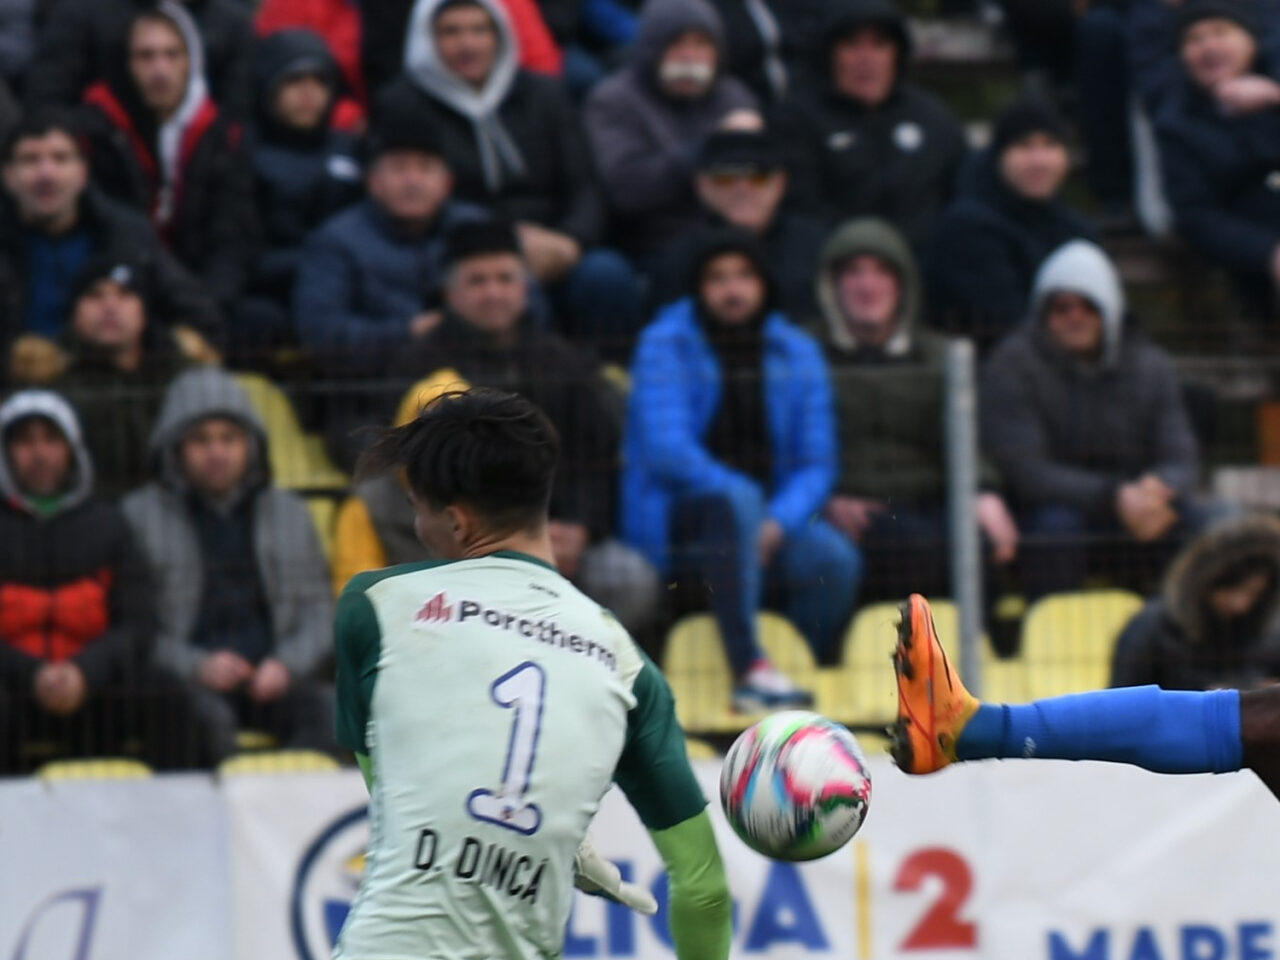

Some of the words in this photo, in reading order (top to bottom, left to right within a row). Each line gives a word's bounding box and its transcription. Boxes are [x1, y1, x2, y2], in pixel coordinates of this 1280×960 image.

[457, 599, 617, 673] Porotherm
[466, 660, 546, 837] 1
[414, 828, 442, 871] D.
[893, 847, 979, 952] 2
